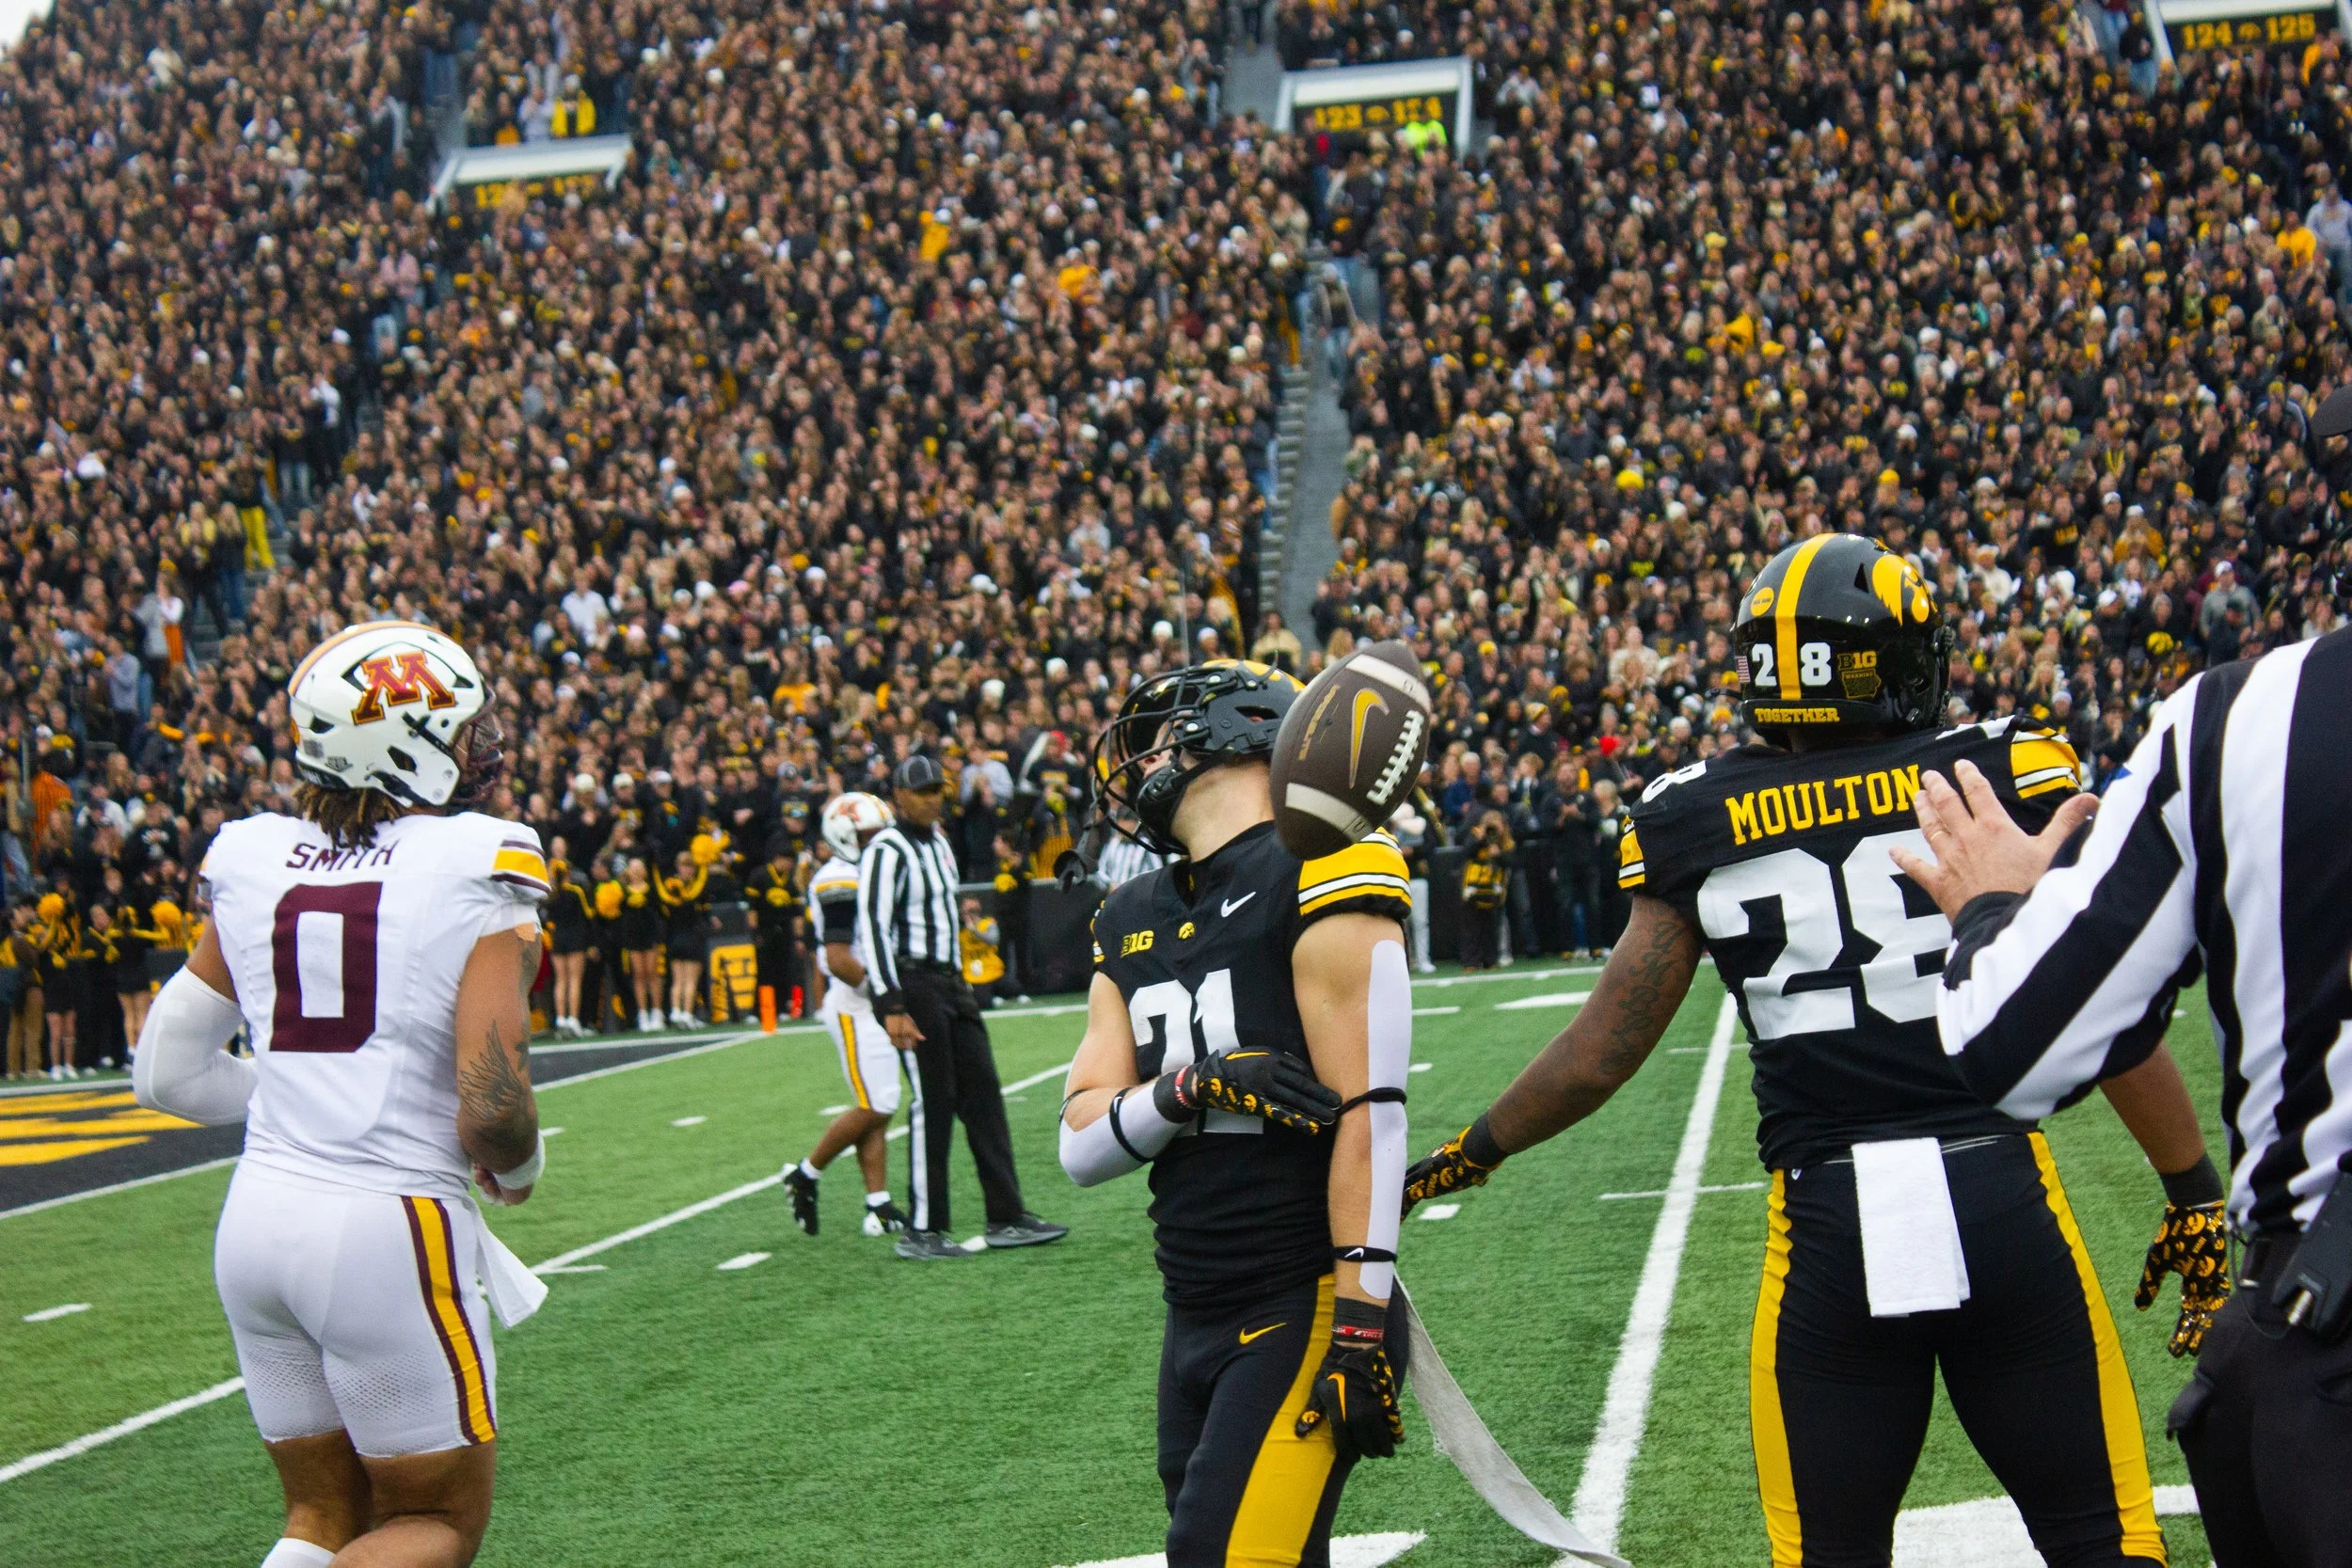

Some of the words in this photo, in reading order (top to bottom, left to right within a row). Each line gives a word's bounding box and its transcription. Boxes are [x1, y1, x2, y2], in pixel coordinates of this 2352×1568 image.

[2183, 22, 2233, 51] 124
[2265, 12, 2315, 43] 125
[351, 650, 456, 726] M
[1754, 707, 1840, 723] TOGETHER
[1724, 764, 1922, 847] MOULTON
[269, 880, 384, 1053] 0
[1128, 968, 1264, 1135] 21
